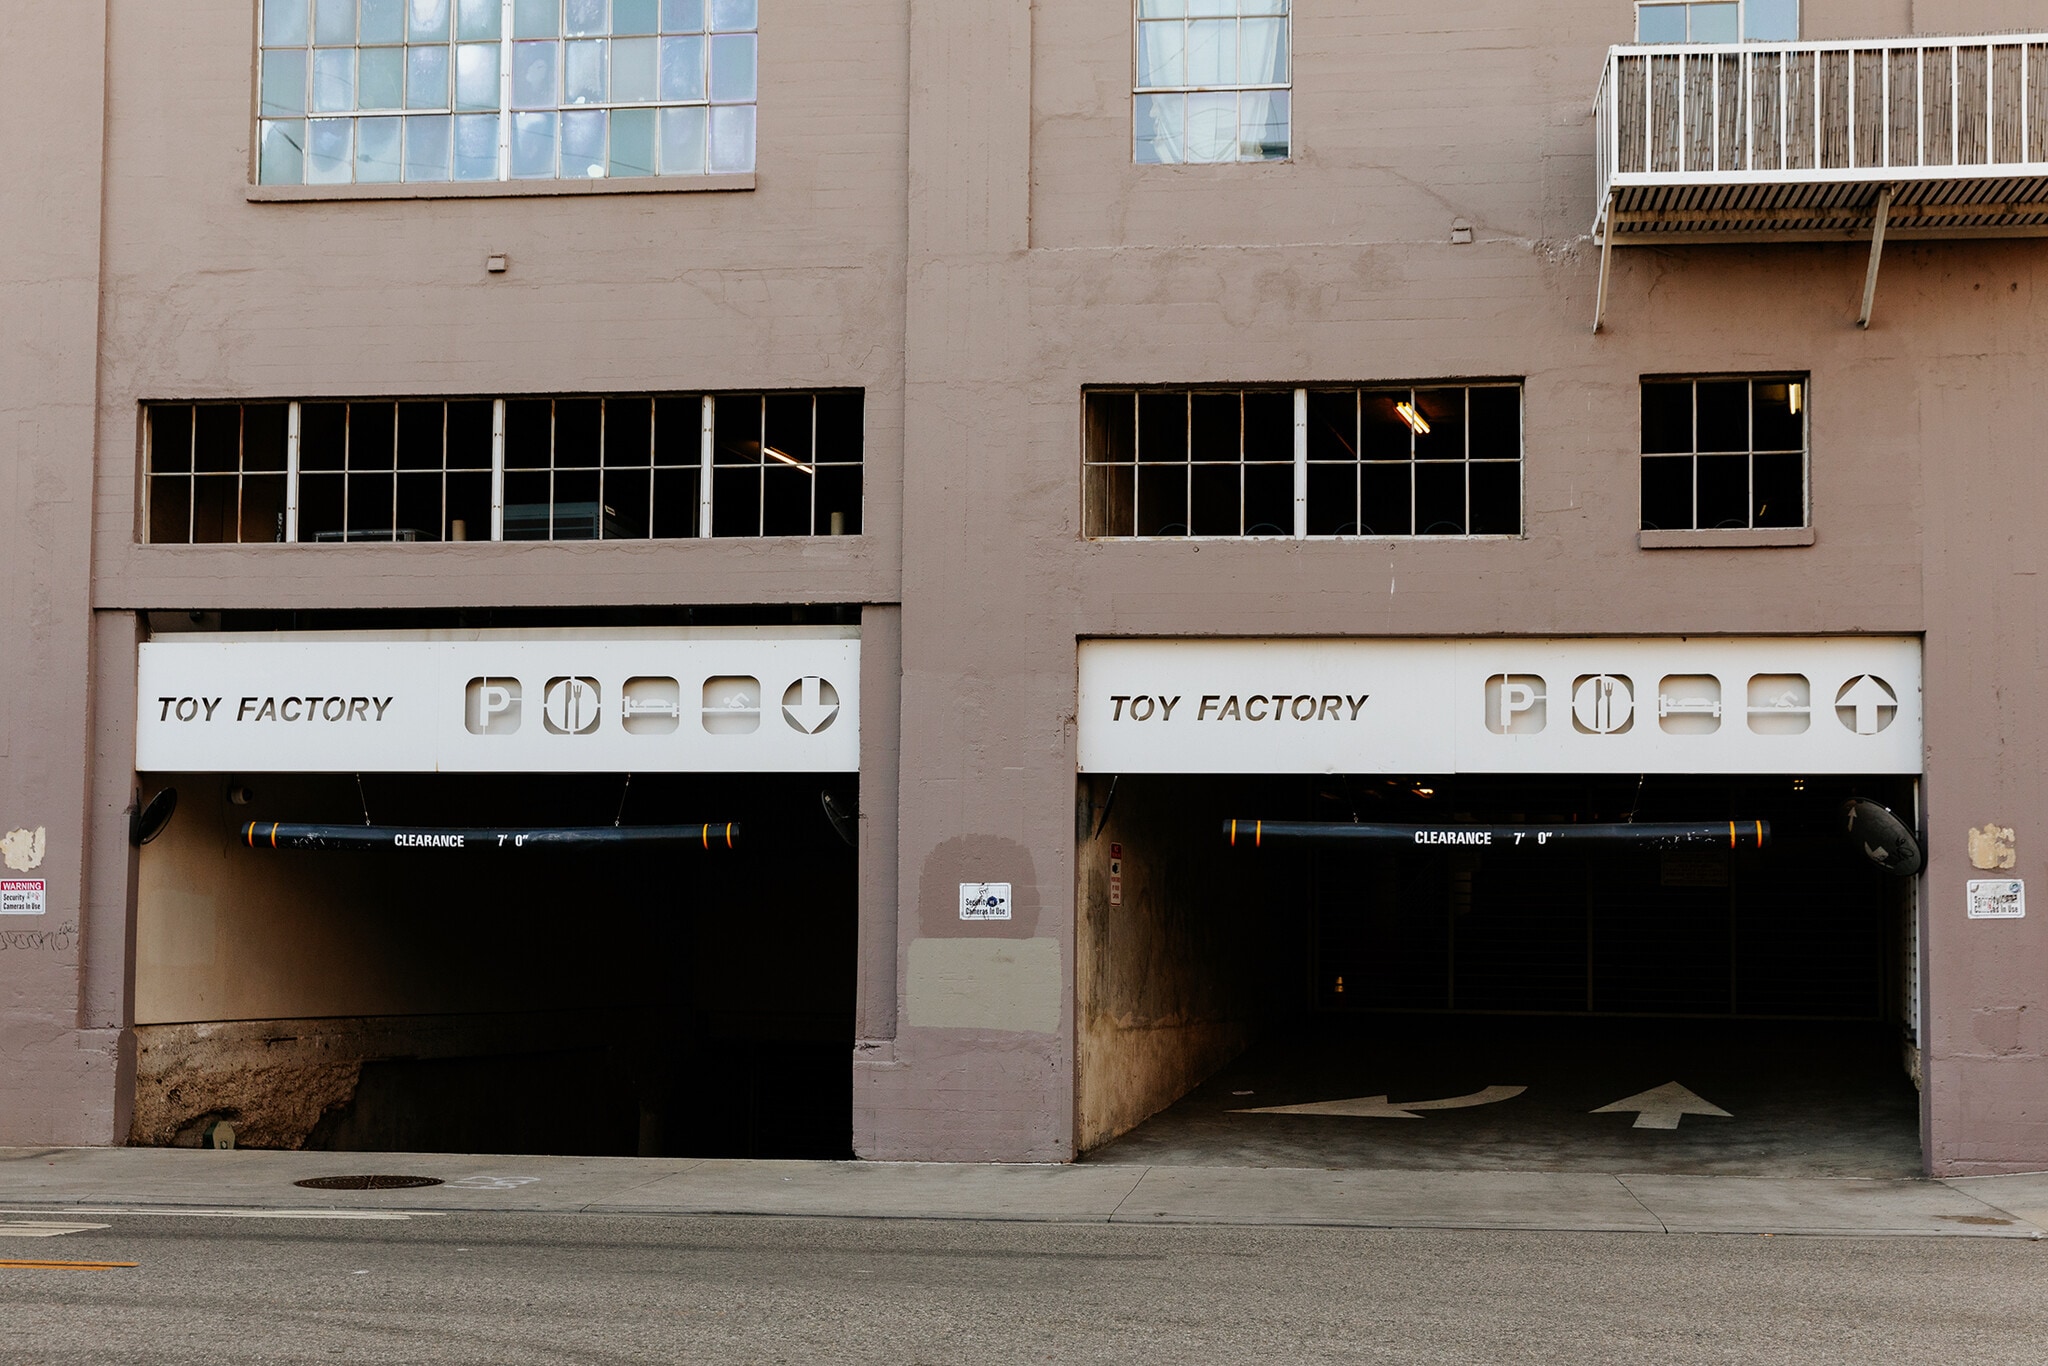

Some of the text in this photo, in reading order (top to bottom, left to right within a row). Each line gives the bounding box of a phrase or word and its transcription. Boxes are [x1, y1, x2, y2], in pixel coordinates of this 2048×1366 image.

[157, 696, 394, 722] TOY FACTORY
[1109, 694, 1370, 722] TOY FACTORY
[393, 833, 465, 848] CLEARANCE
[1414, 831, 1492, 845] CLEARANCE
[2, 882, 41, 890] WARNING
[3, 894, 25, 903] Security
[965, 898, 989, 907] Secrity
[965, 907, 988, 915] Caeras
[996, 907, 1005, 915] Use
